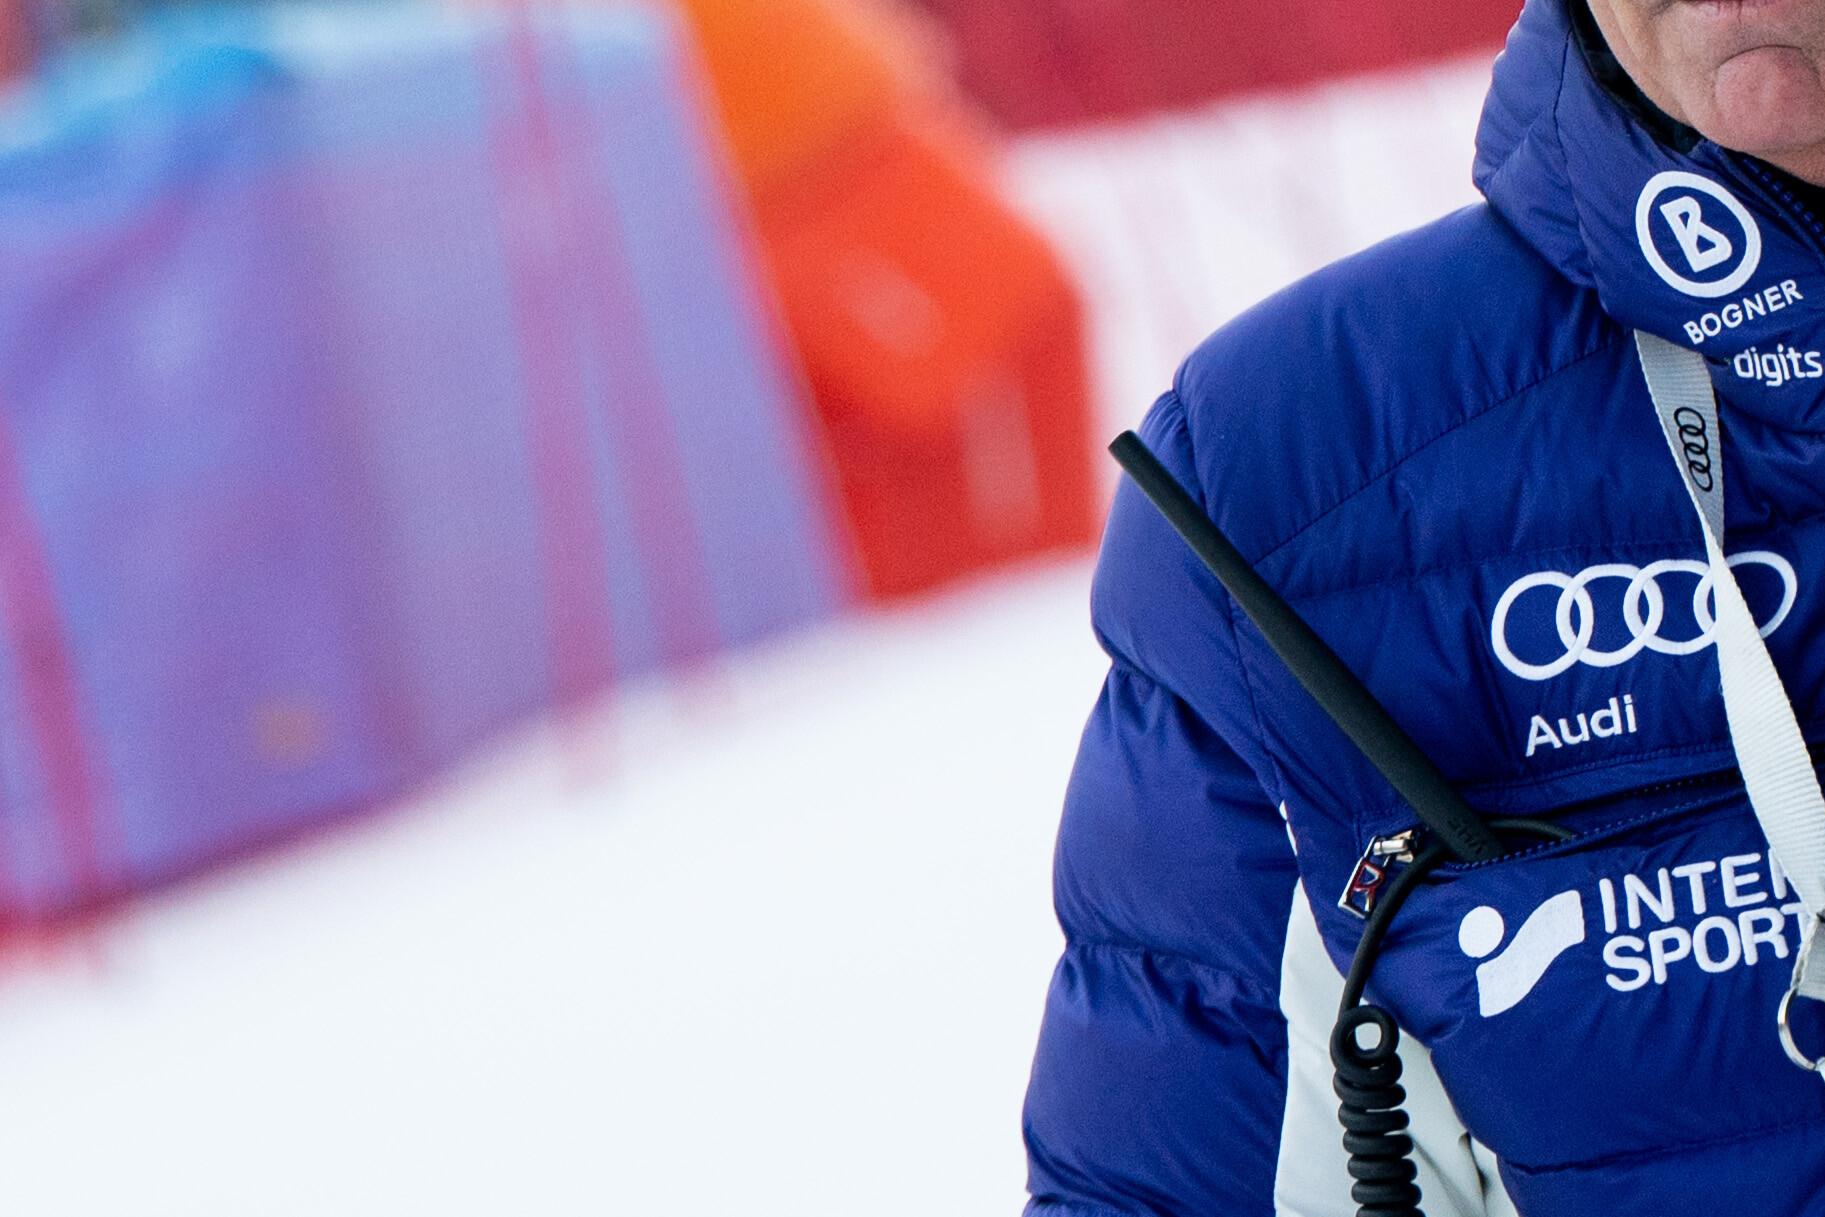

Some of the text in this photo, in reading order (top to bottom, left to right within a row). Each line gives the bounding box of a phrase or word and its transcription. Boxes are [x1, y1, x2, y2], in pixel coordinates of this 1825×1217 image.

[1682, 279, 1804, 345] BOGNER
[1733, 343, 1823, 387] digits
[1525, 694, 1638, 757] Audi
